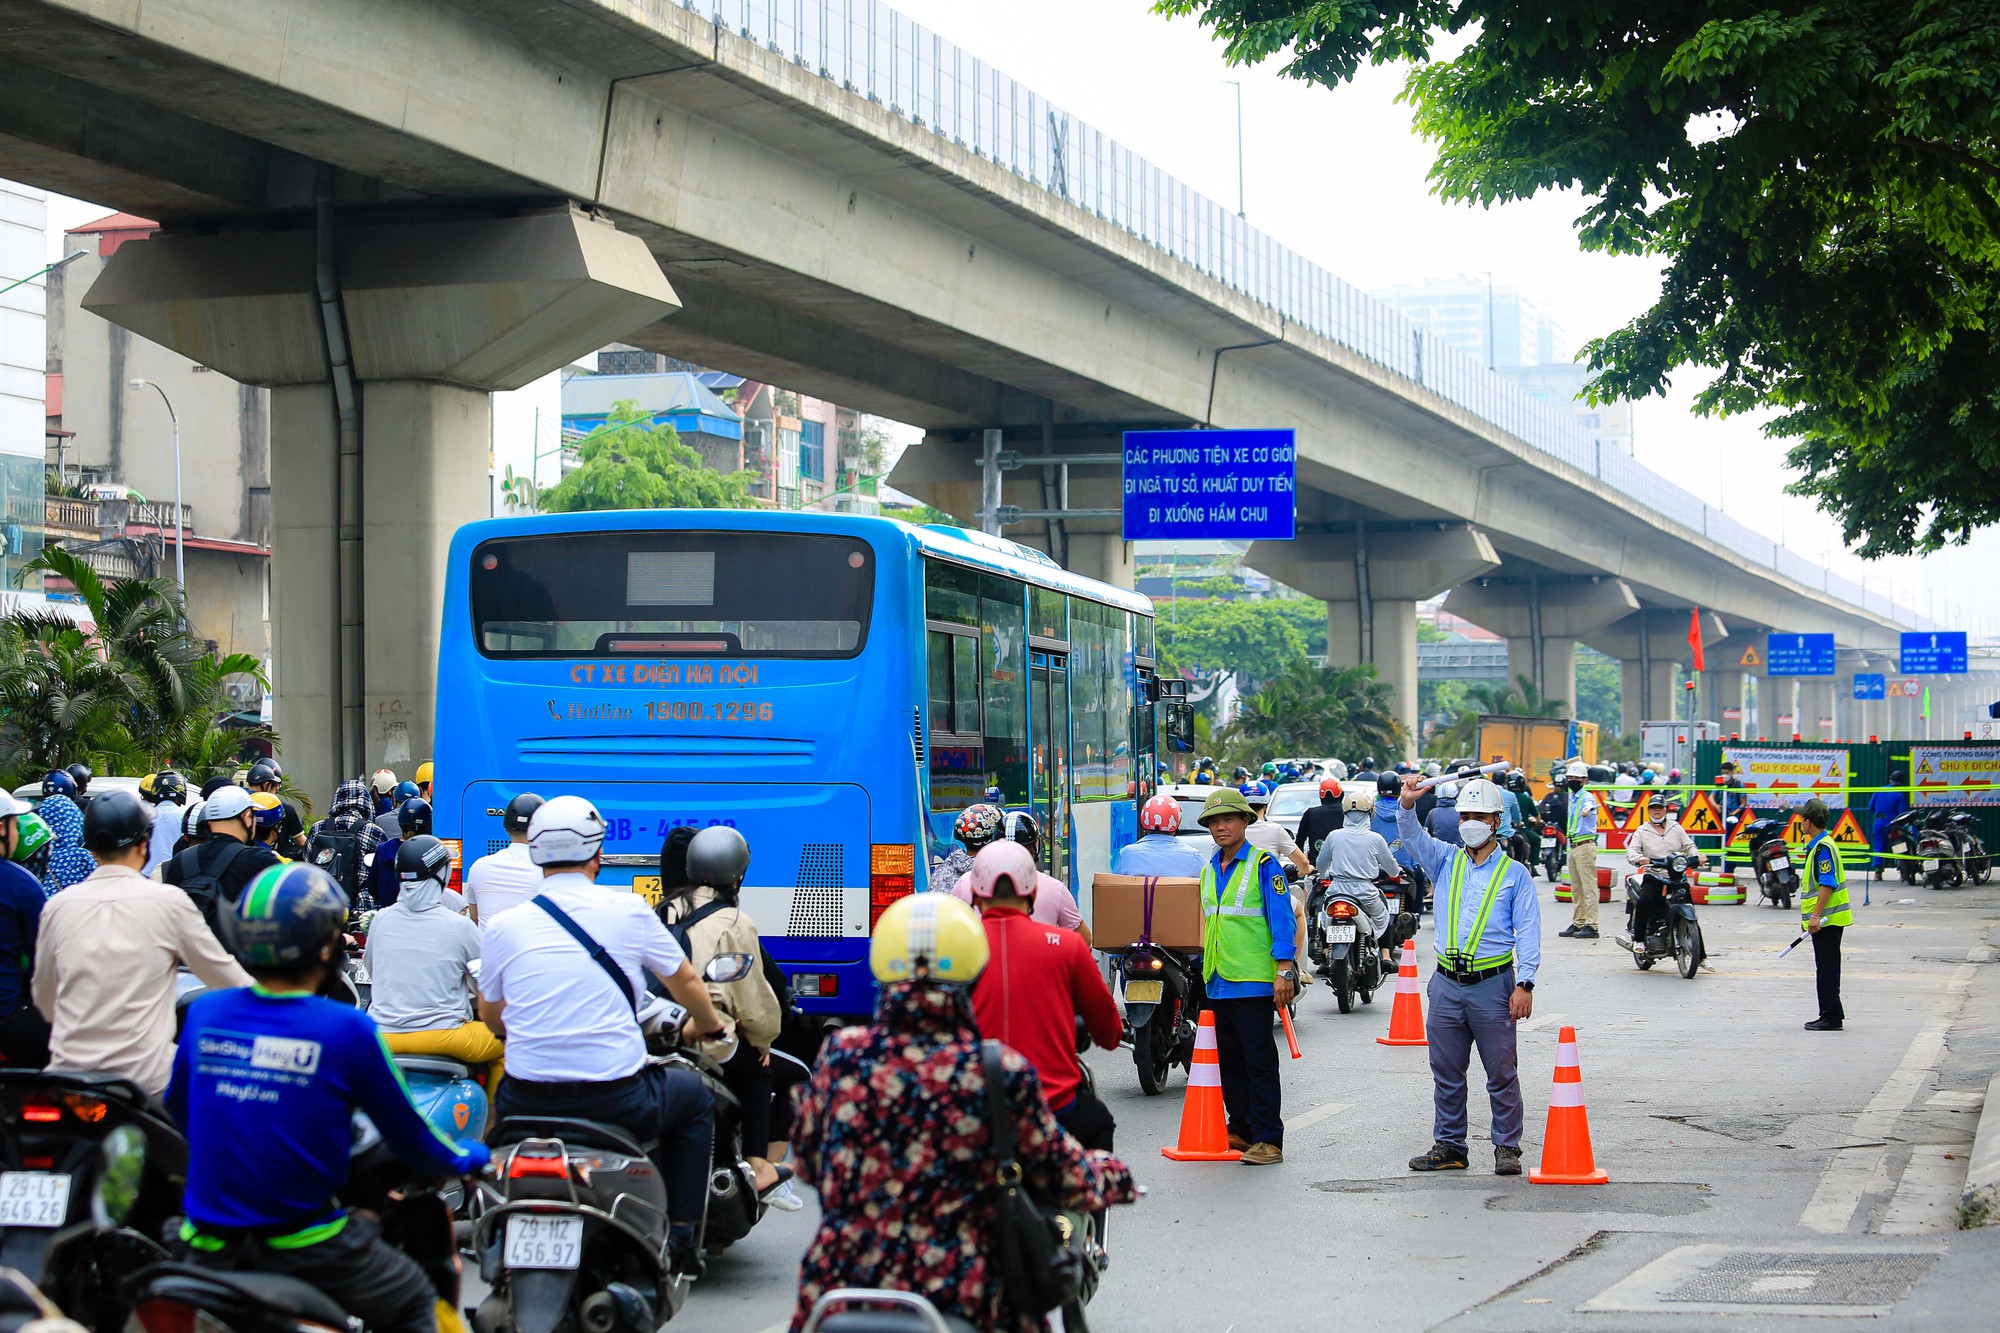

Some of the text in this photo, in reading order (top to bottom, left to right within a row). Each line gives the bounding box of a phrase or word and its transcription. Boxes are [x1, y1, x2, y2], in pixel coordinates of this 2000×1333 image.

[1125, 443, 1292, 466] CÁC PHƯƠNG TIỆN XE CƠ GIỚI
[1125, 479, 1136, 494] ĐI
[1139, 476, 1161, 493] NGÃ
[1164, 477, 1180, 493] TƯ
[1202, 472, 1238, 493] KHUẤT
[1241, 477, 1265, 492] DUY
[1267, 471, 1292, 492] TIẾN
[1149, 508, 1160, 523] ĐI
[1165, 502, 1205, 523] XUỐNG
[1240, 507, 1268, 522] CHUI
[570, 664, 597, 684] CT
[601, 664, 627, 684] XE
[686, 660, 714, 684] HÀ
[567, 701, 774, 721] Hotline 1900.1296
[1939, 760, 1960, 770] CHÚ
[1962, 760, 1970, 770] Ý
[1972, 762, 1982, 770] ĐI
[23, 828, 46, 848] Grab
